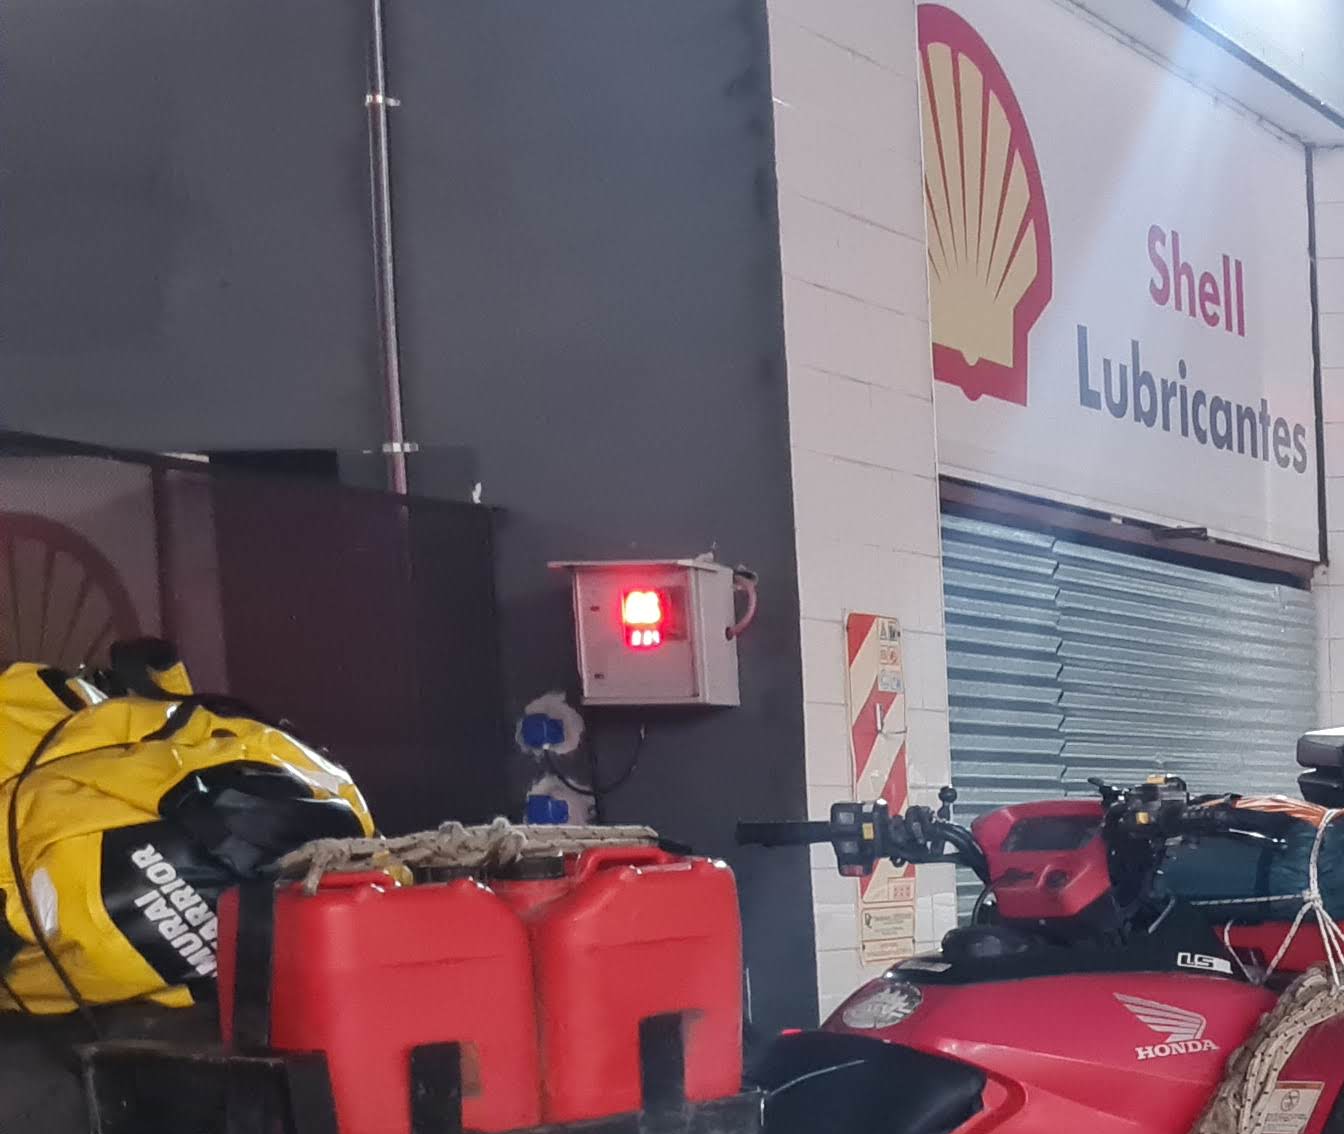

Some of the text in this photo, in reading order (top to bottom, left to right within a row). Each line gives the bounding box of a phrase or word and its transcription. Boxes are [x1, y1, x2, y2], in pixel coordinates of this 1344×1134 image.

[1147, 223, 1246, 338] Shell
[1077, 323, 1308, 474] Lubricantes
[131, 843, 218, 950] ARRIOR
[134, 889, 218, 978] MURAI
[1135, 1039, 1220, 1060] HONDA
